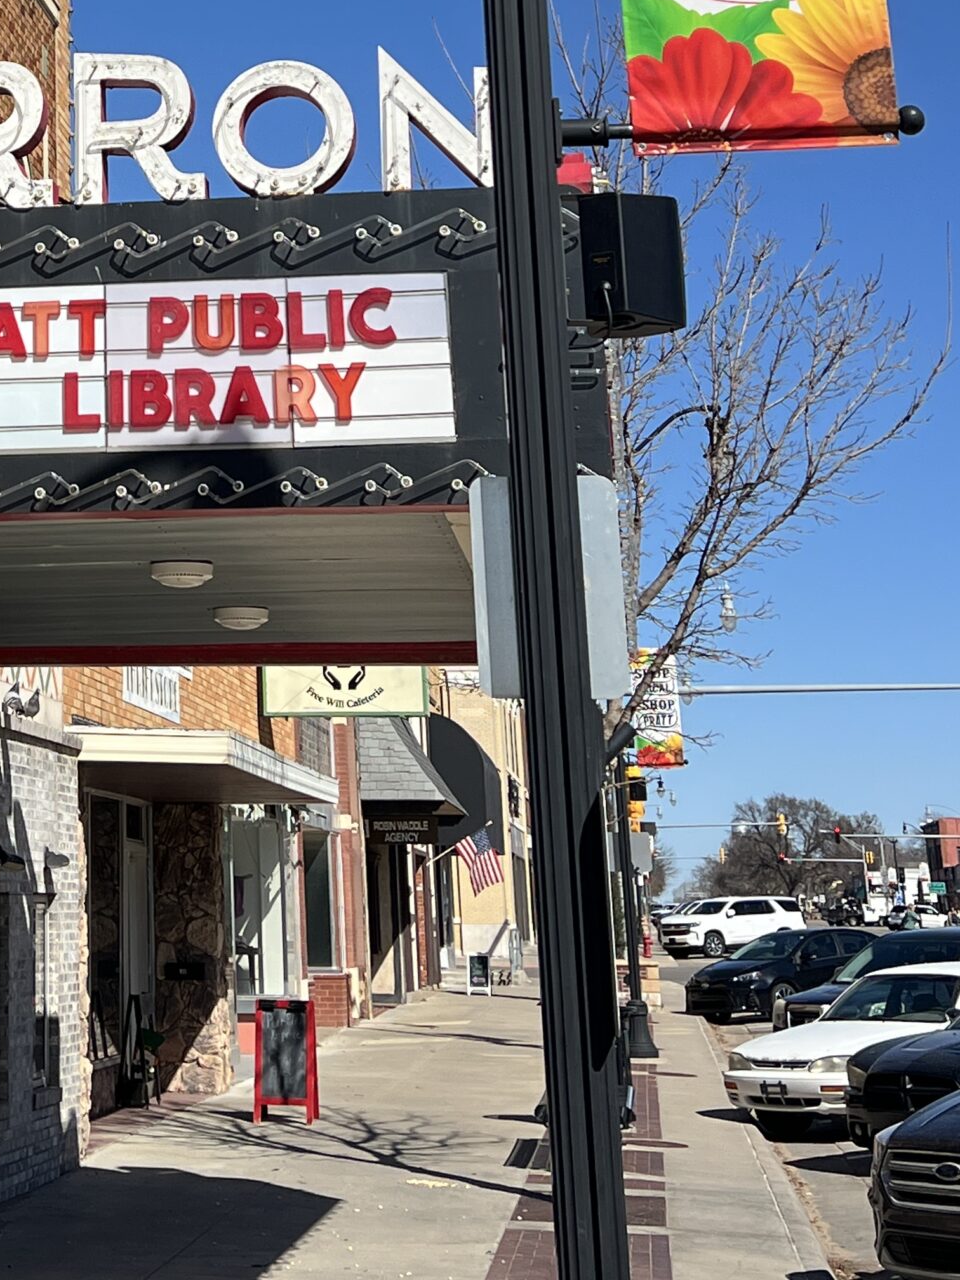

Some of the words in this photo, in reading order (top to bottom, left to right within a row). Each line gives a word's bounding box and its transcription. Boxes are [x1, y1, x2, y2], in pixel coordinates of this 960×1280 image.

[147, 288, 396, 358] PUBLIC
[62, 362, 367, 433] LIBRARY
[306, 686, 325, 703] Free
[326, 696, 344, 708] Will
[346, 686, 384, 708] Cafeteria
[641, 699, 675, 710] SHOP
[644, 714, 673, 725] PRATT
[373, 821, 396, 831] ROBIN
[384, 832, 420, 842] AGENCY
